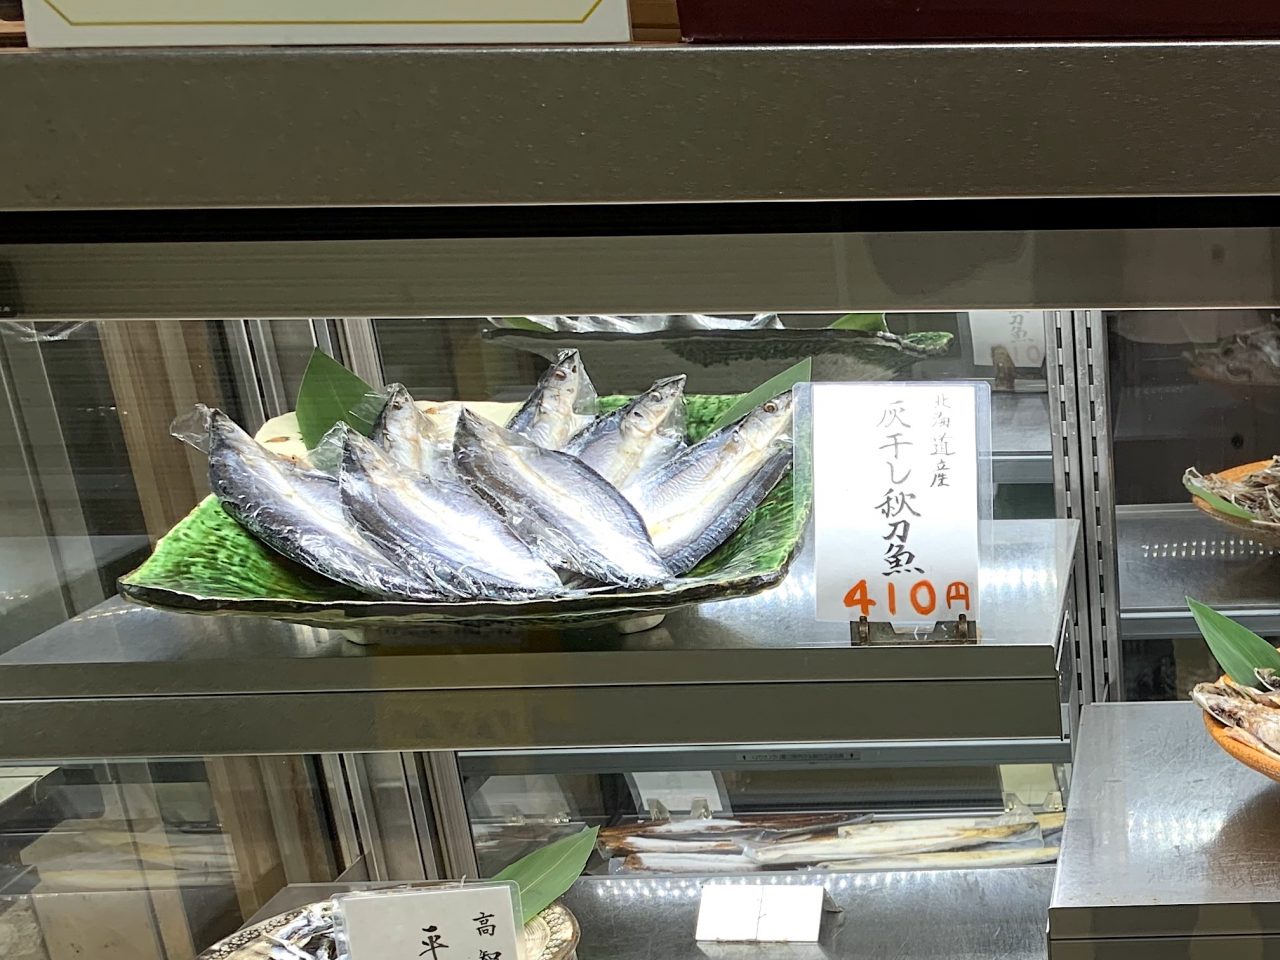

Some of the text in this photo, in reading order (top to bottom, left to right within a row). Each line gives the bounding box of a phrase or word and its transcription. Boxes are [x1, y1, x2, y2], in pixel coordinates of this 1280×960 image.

[1009, 311, 1034, 343] 刀魚
[874, 400, 926, 577] 灰干し秋刀魚
[842, 579, 971, 616] 410円
